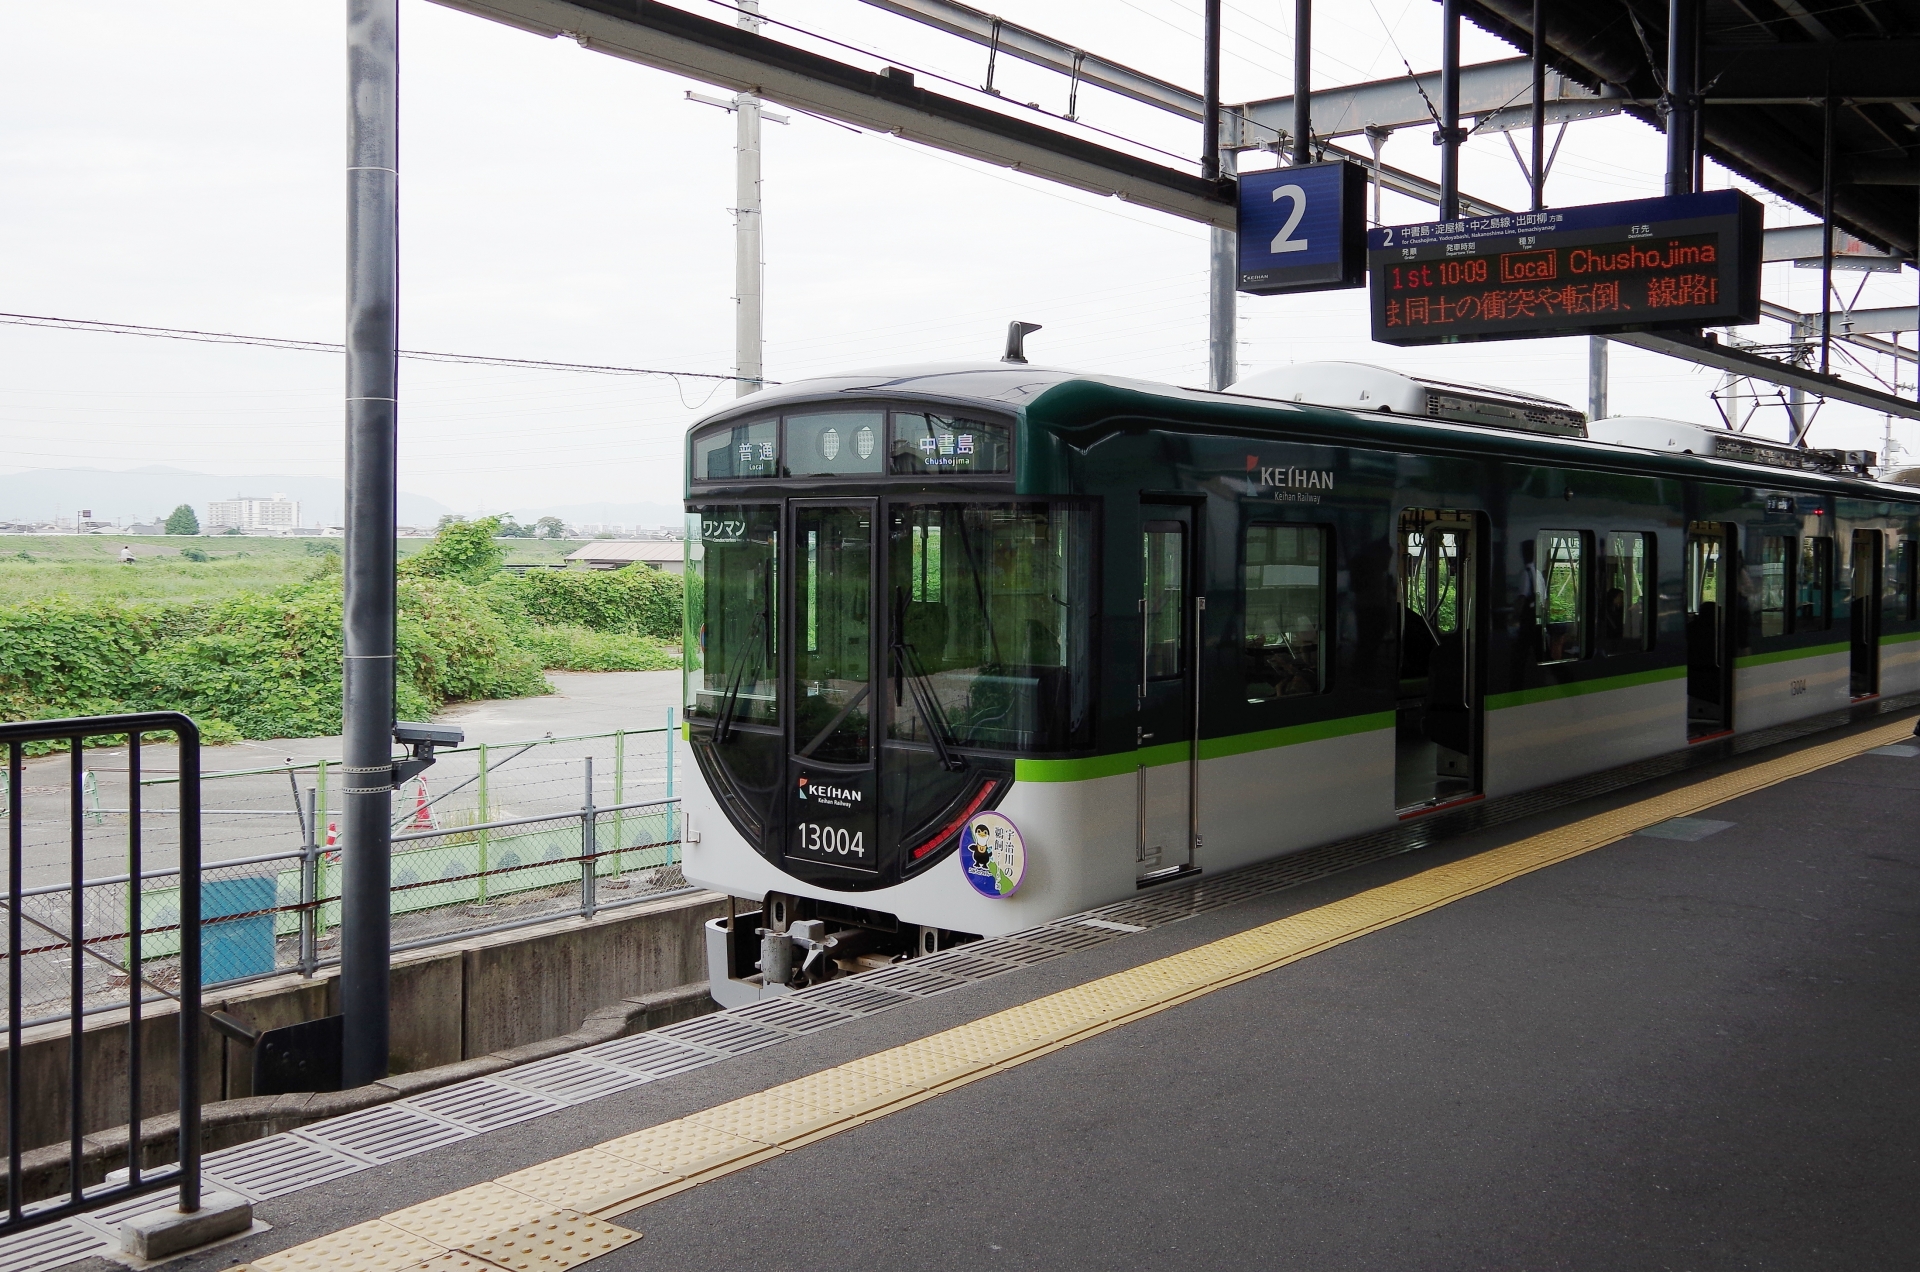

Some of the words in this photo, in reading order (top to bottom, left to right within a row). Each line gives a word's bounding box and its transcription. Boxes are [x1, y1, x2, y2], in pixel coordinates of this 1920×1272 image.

[1271, 184, 1308, 254] 2
[1383, 228, 1394, 247] 2
[1471, 230, 1504, 238] Nakanoshima
[1518, 224, 1556, 234] Demachiyanagi
[1631, 225, 1650, 234] 行先
[1446, 242, 1476, 252] 発車時刻
[1519, 236, 1536, 245] 種別
[1440, 259, 1487, 285] 10:09
[1505, 254, 1553, 280] Local
[1570, 240, 1716, 274] Chushojima
[739, 442, 774, 462] 普通
[920, 433, 975, 455] 中書島
[924, 456, 970, 467] Chushojima
[1274, 491, 1296, 501] Keihan
[1297, 492, 1321, 505] Railway
[702, 520, 746, 537] ワンマン
[818, 797, 834, 805] Keihan
[833, 800, 852, 808] Railway
[798, 822, 865, 858] 13004
[1004, 828, 1015, 877] 宇治川の
